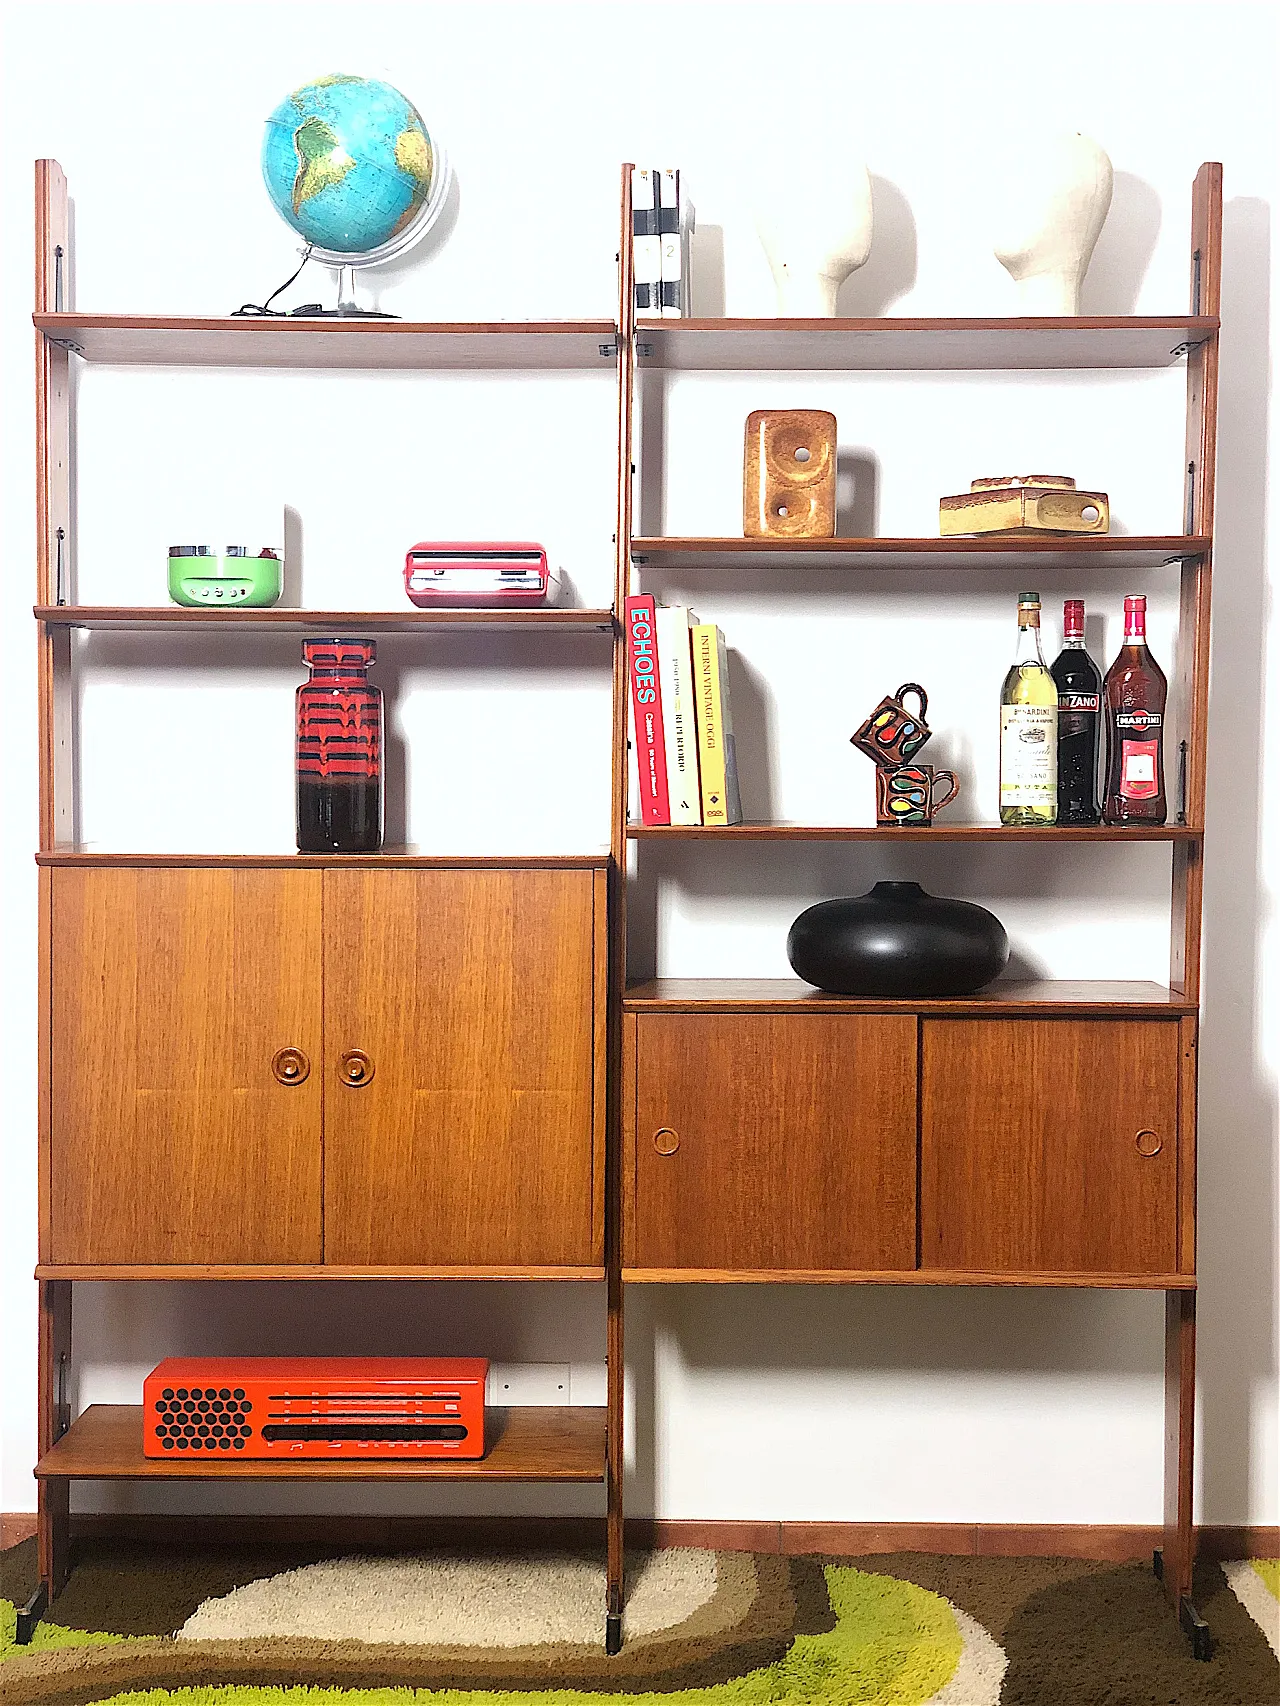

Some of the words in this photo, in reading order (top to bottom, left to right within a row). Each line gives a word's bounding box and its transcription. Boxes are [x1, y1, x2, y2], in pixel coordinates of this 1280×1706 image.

[666, 245, 675, 258] 2
[700, 635, 711, 675] INTERNI
[631, 608, 656, 704] ECHOES
[645, 712, 655, 744] Cassina
[703, 677, 714, 722] VINTAGE
[1058, 695, 1097, 708] INZANO
[1119, 716, 1160, 725] MARTINI
[705, 723, 716, 749] OGGI
